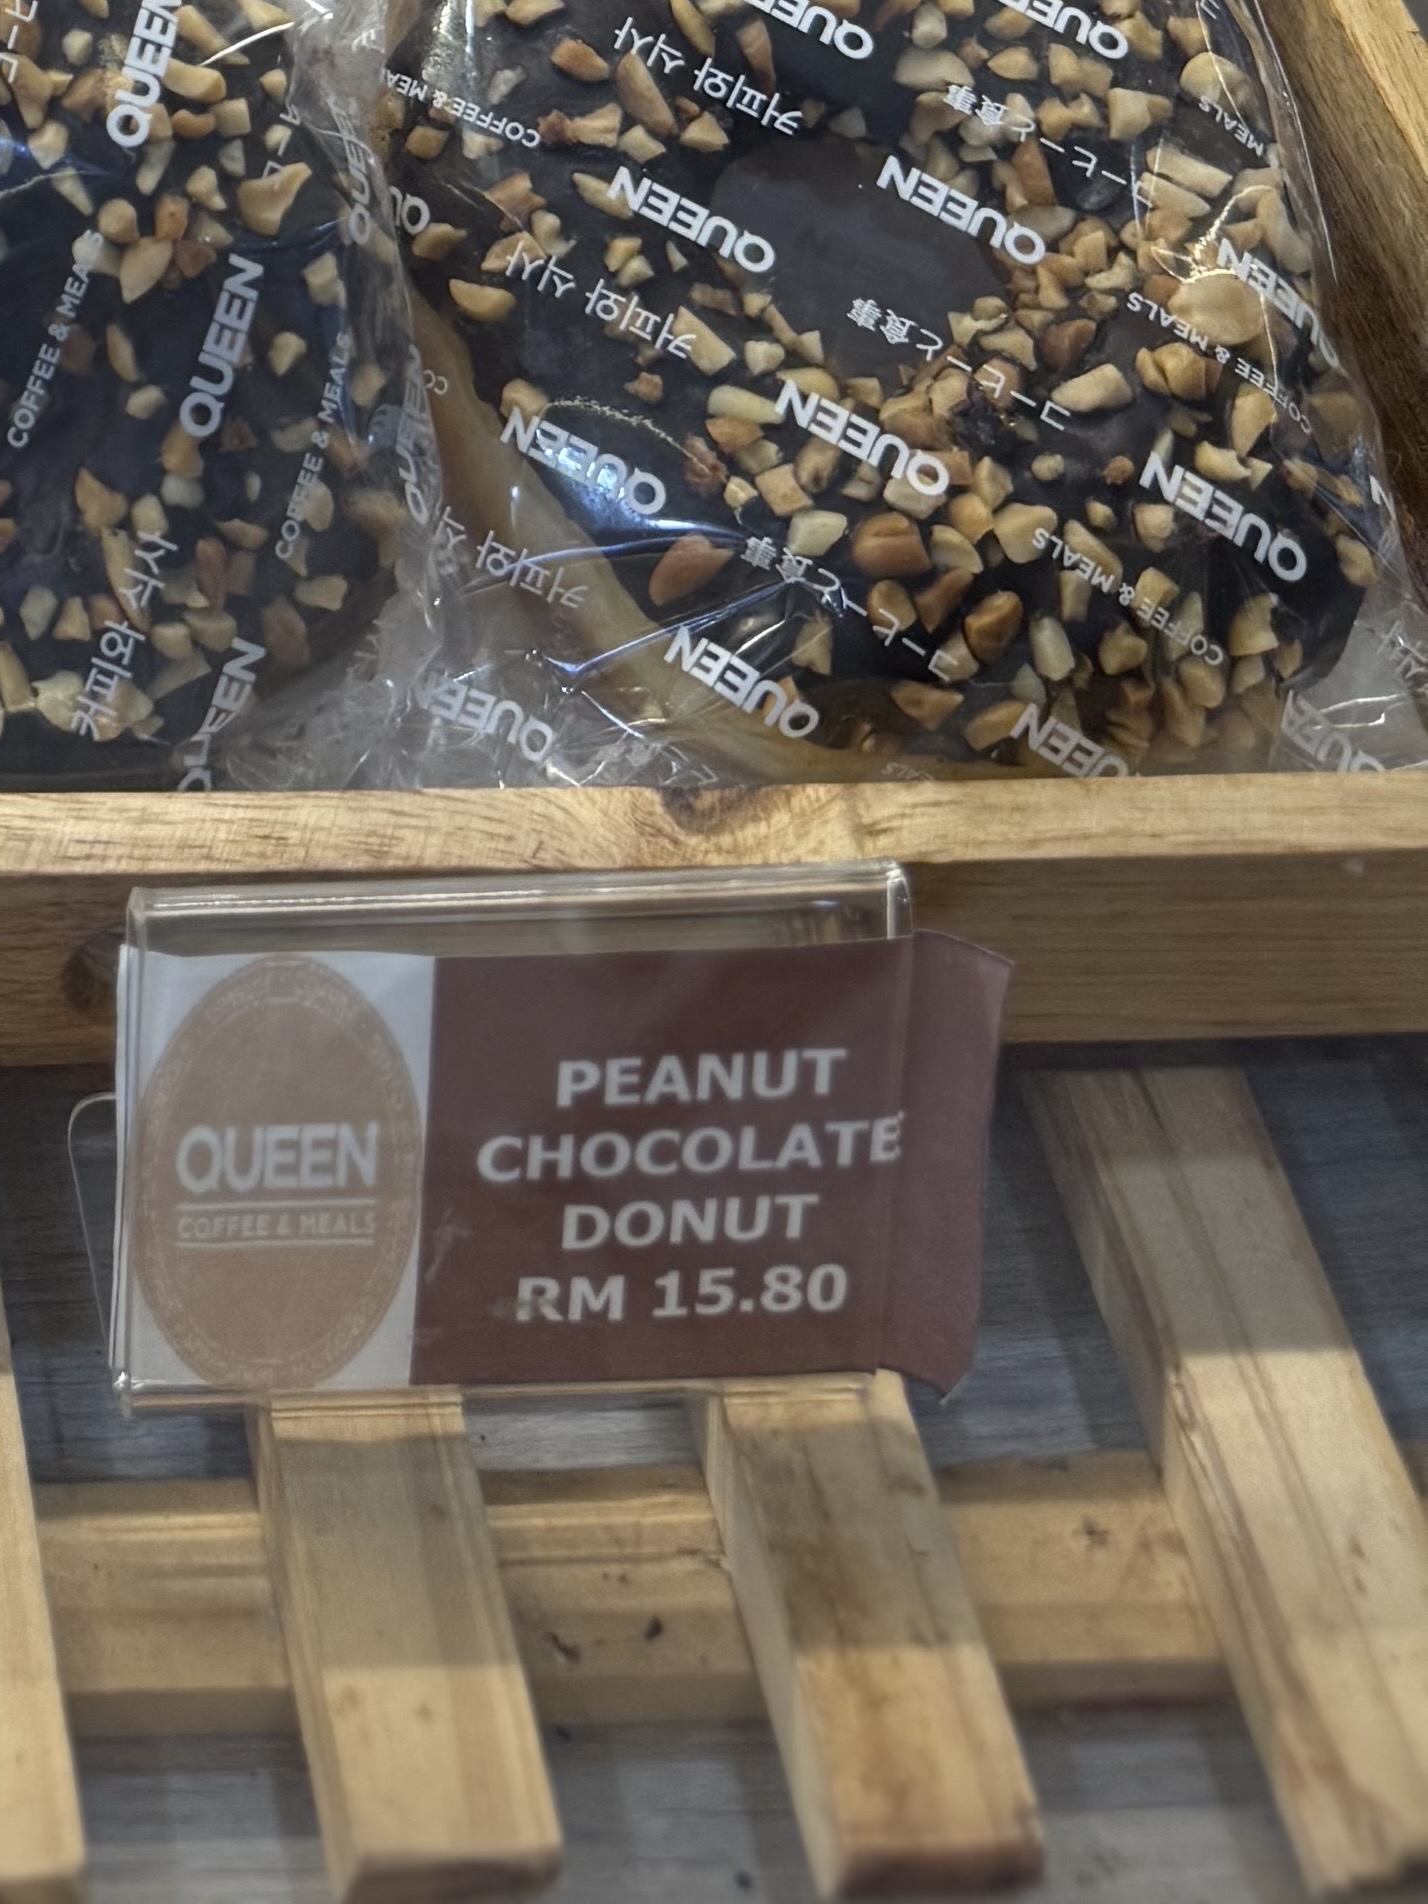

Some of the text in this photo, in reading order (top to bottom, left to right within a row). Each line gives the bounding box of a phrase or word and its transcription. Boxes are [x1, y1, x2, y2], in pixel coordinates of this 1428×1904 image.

[449, 102, 541, 148] COFFEE
[614, 17, 805, 138] 커피와 식사
[1198, 95, 1263, 157] MEALS
[606, 166, 775, 273] QUEEN
[876, 155, 1046, 265] QUEEN
[7, 230, 104, 448] COFFEE & MEALS
[179, 253, 264, 438] QUEEN
[505, 248, 698, 361] 커피와 식사
[1127, 292, 1209, 352] MEALS
[1215, 346, 1232, 364] &
[847, 297, 1072, 431] コーヒーと食事
[1235, 358, 1312, 434] COFFEE
[501, 406, 667, 515] QUEEN
[774, 379, 949, 496] QUEEN
[274, 428, 329, 559] COFFEE &
[1139, 450, 1307, 581] QUEEN
[474, 531, 587, 610] 커피와
[742, 536, 959, 682] コーヒーと食事
[1032, 528, 1224, 665] COFFEE & MEALS
[70, 531, 179, 742] 커피와 식사
[664, 624, 819, 738] QUEEN
[556, 1047, 847, 1108] PEANUT
[175, 1121, 378, 1194] QUEEN
[476, 1112, 904, 1184] CHOCOLATE
[178, 1212, 374, 1240] COFFEE & MEALS
[561, 1194, 819, 1251] DONUT
[514, 1264, 849, 1323] RM 15.80
